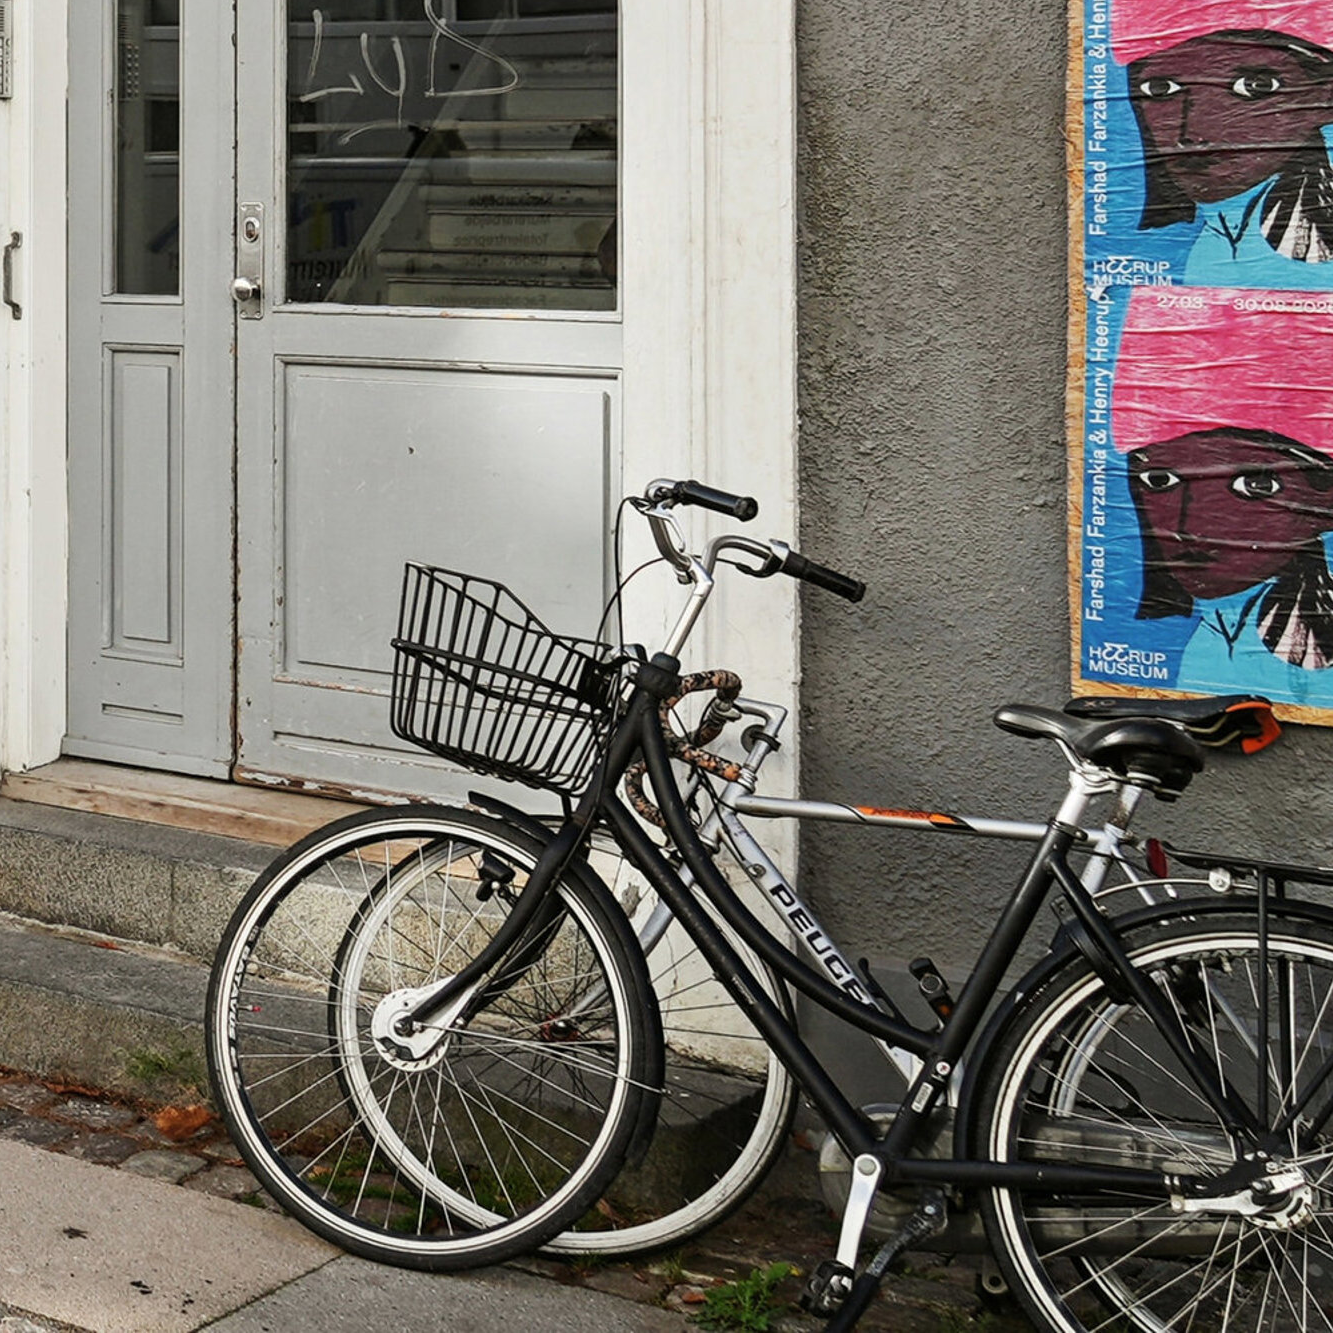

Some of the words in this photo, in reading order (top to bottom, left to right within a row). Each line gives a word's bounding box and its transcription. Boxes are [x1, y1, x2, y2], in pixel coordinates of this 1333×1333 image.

[1089, 45, 1106, 58] &
[1088, 63, 1107, 152] Farzankia
[1088, 161, 1107, 236] Farshad
[1090, 293, 1114, 362] Heerup
[1089, 367, 1113, 424] Henry
[1089, 429, 1107, 445] &
[1087, 449, 1107, 538] Farzankia
[1085, 545, 1105, 621] Farshad
[1089, 660, 1168, 680] MUSEUM
[769, 883, 866, 1002] PEUGE
